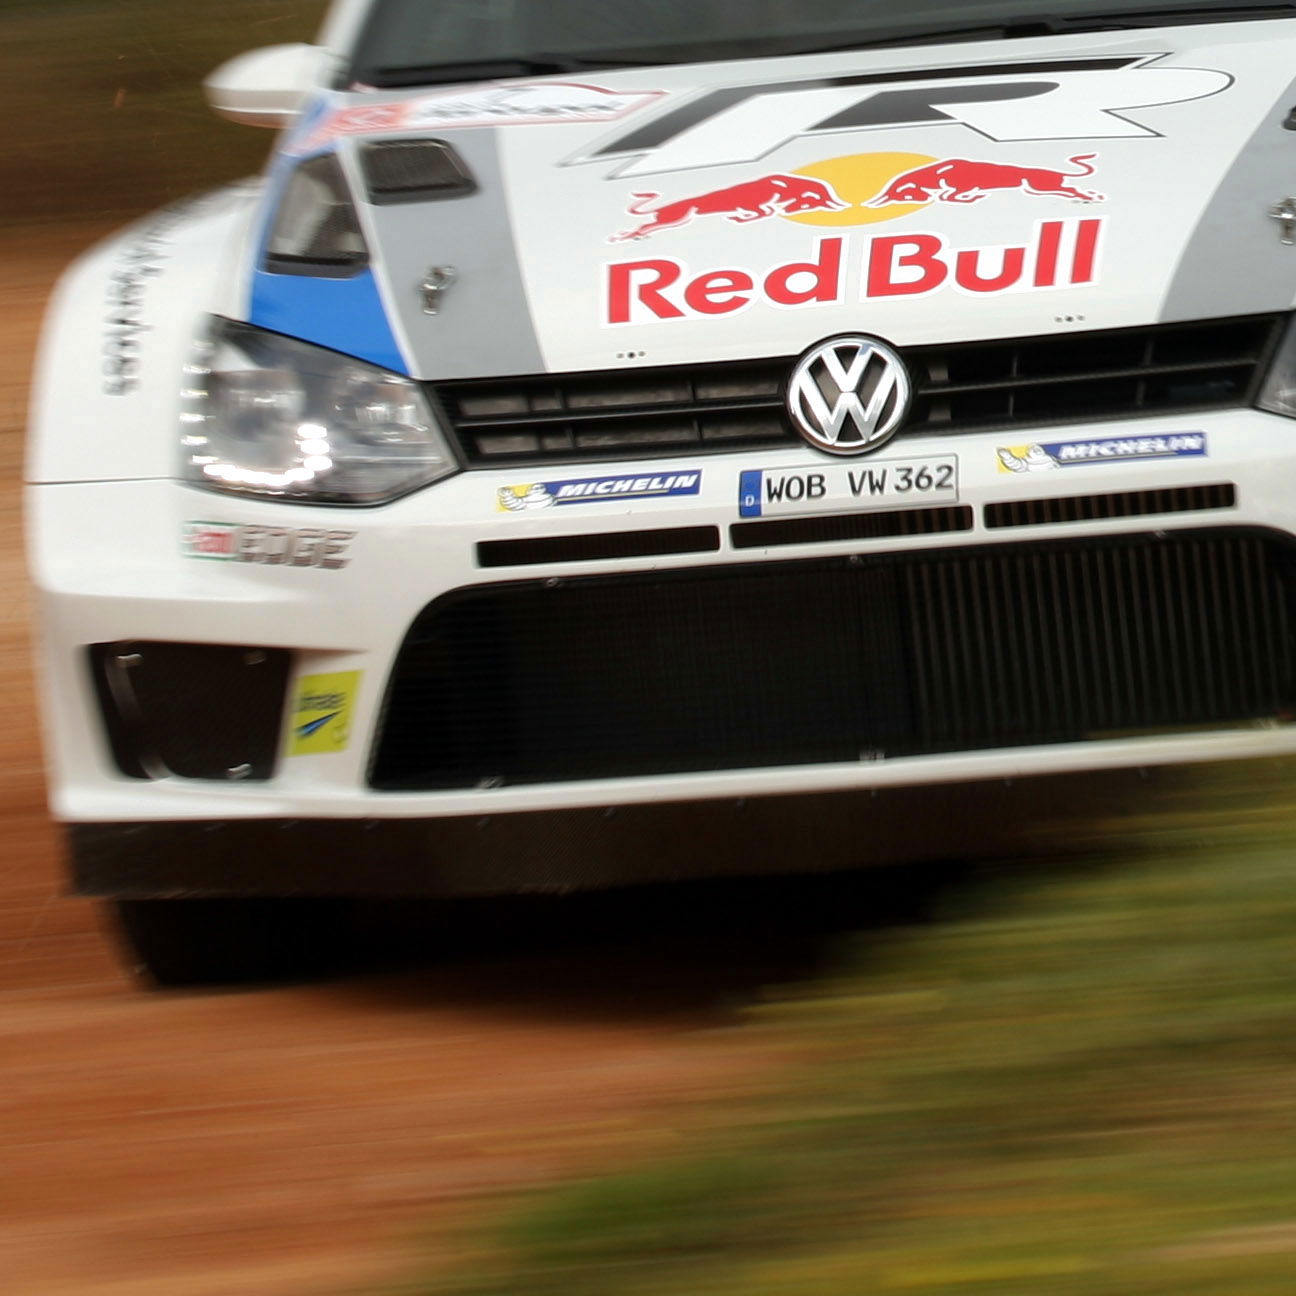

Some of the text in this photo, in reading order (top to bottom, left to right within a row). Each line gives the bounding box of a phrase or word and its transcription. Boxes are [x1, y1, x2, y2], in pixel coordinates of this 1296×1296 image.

[607, 218, 1102, 324] Red Bull
[1059, 435, 1205, 459] MICHELIN
[556, 473, 698, 498] MICHELIN
[745, 463, 955, 507] D WOB VW 362
